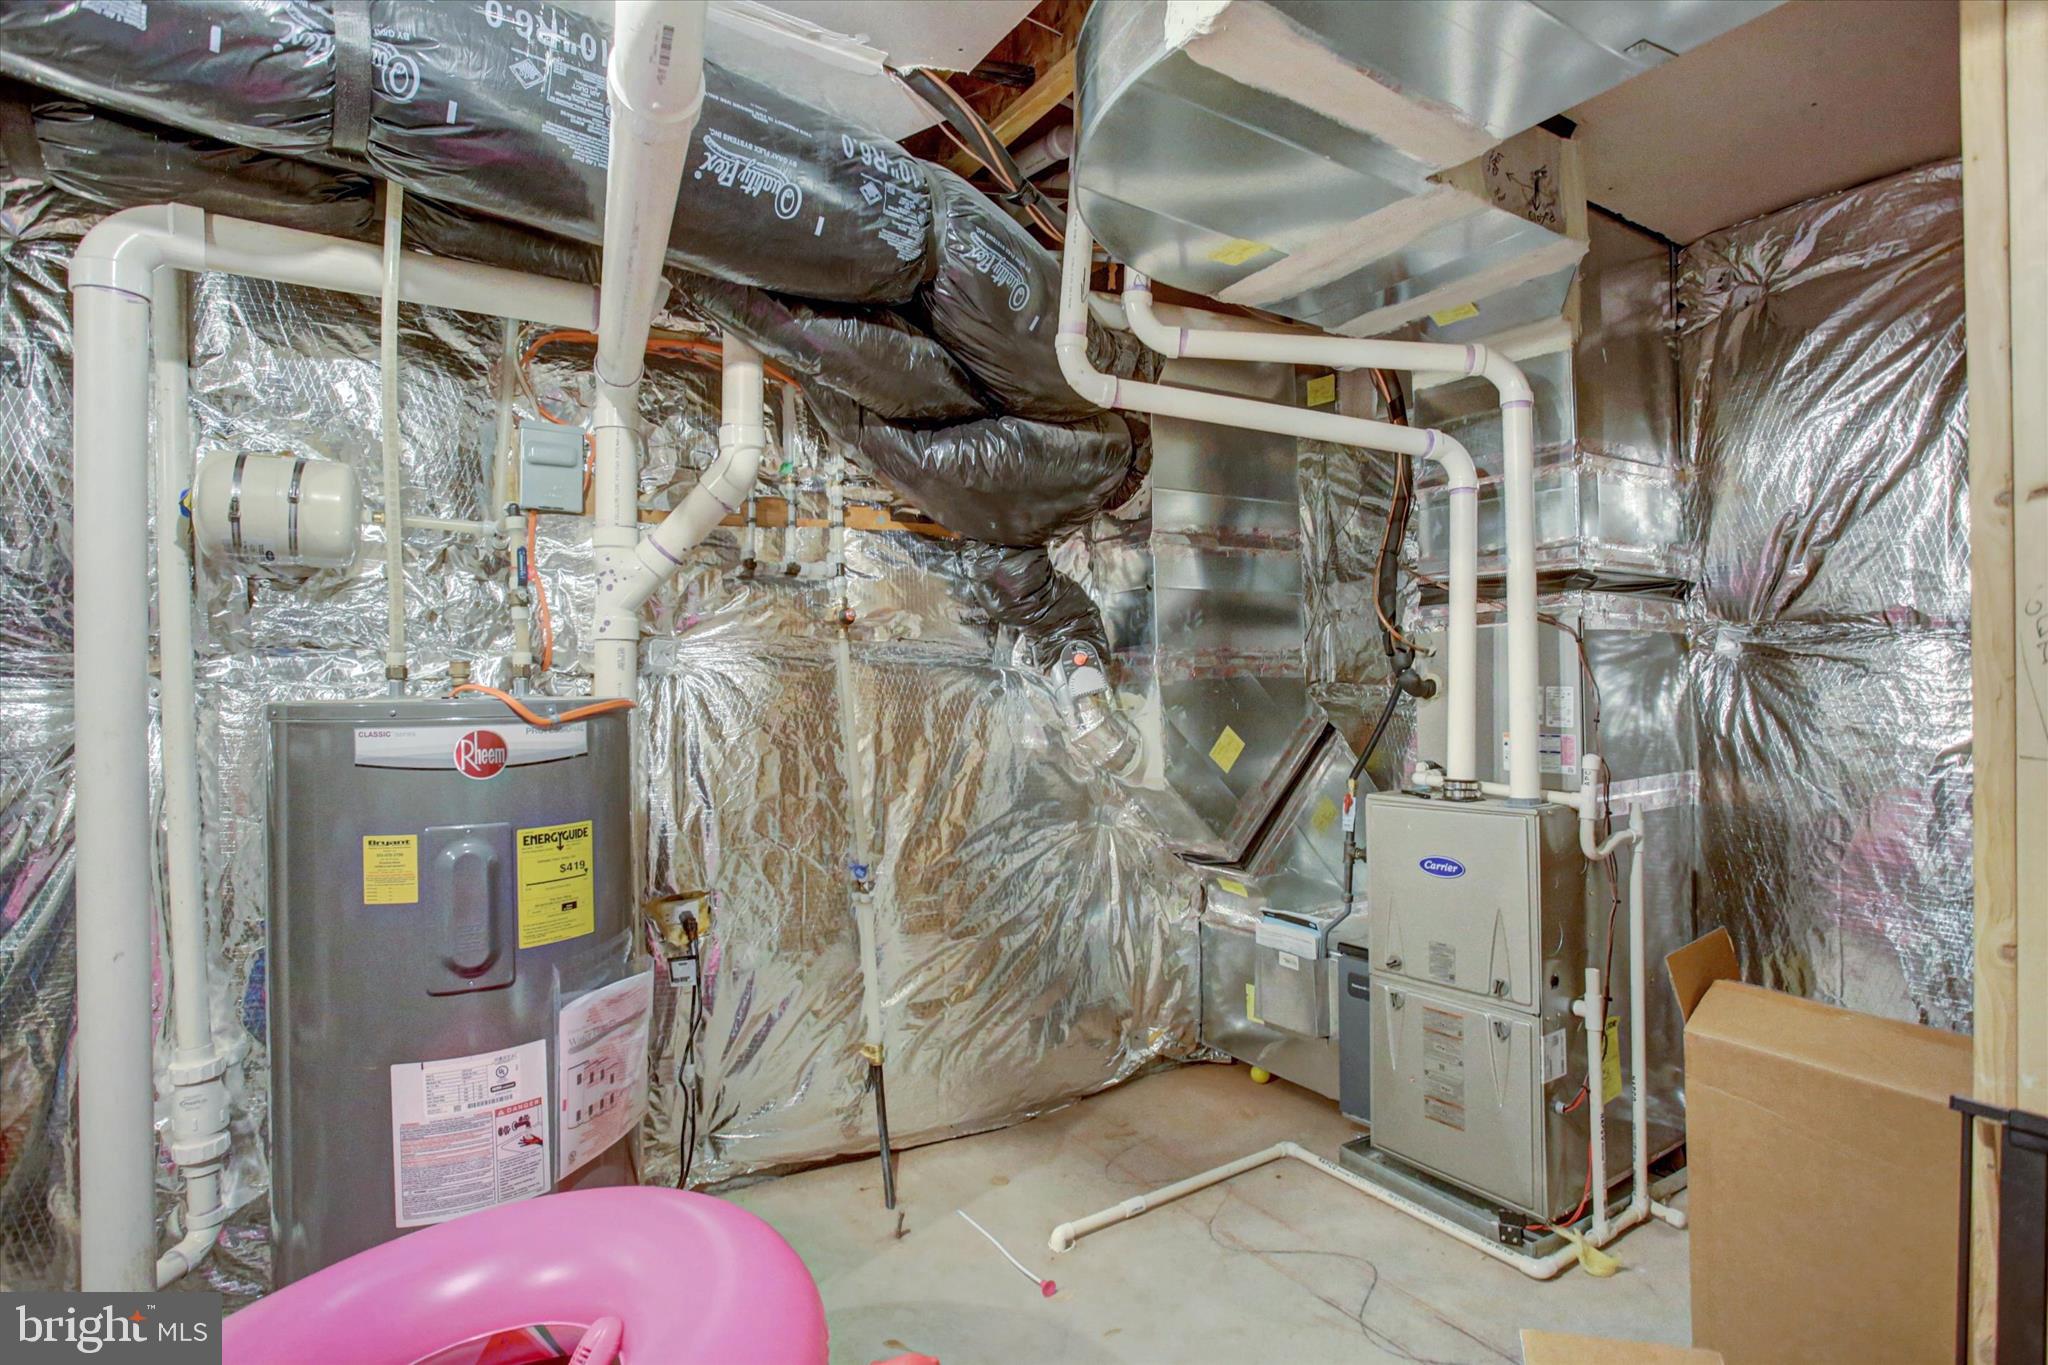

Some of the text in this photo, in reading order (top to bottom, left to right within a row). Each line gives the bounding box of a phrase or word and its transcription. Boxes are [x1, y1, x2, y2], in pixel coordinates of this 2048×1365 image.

[707, 127, 723, 140] INC.
[722, 131, 754, 152] SYSTEMS
[698, 151, 803, 220] Quality Flex
[966, 243, 995, 274] Flex
[991, 257, 1031, 312] Quality
[357, 730, 392, 739] CLASSIC
[459, 731, 507, 772] Rheem
[522, 826, 589, 852] ENERGYGUIDE
[1423, 859, 1459, 873] Carrier
[506, 1098, 541, 1114] DANGER
